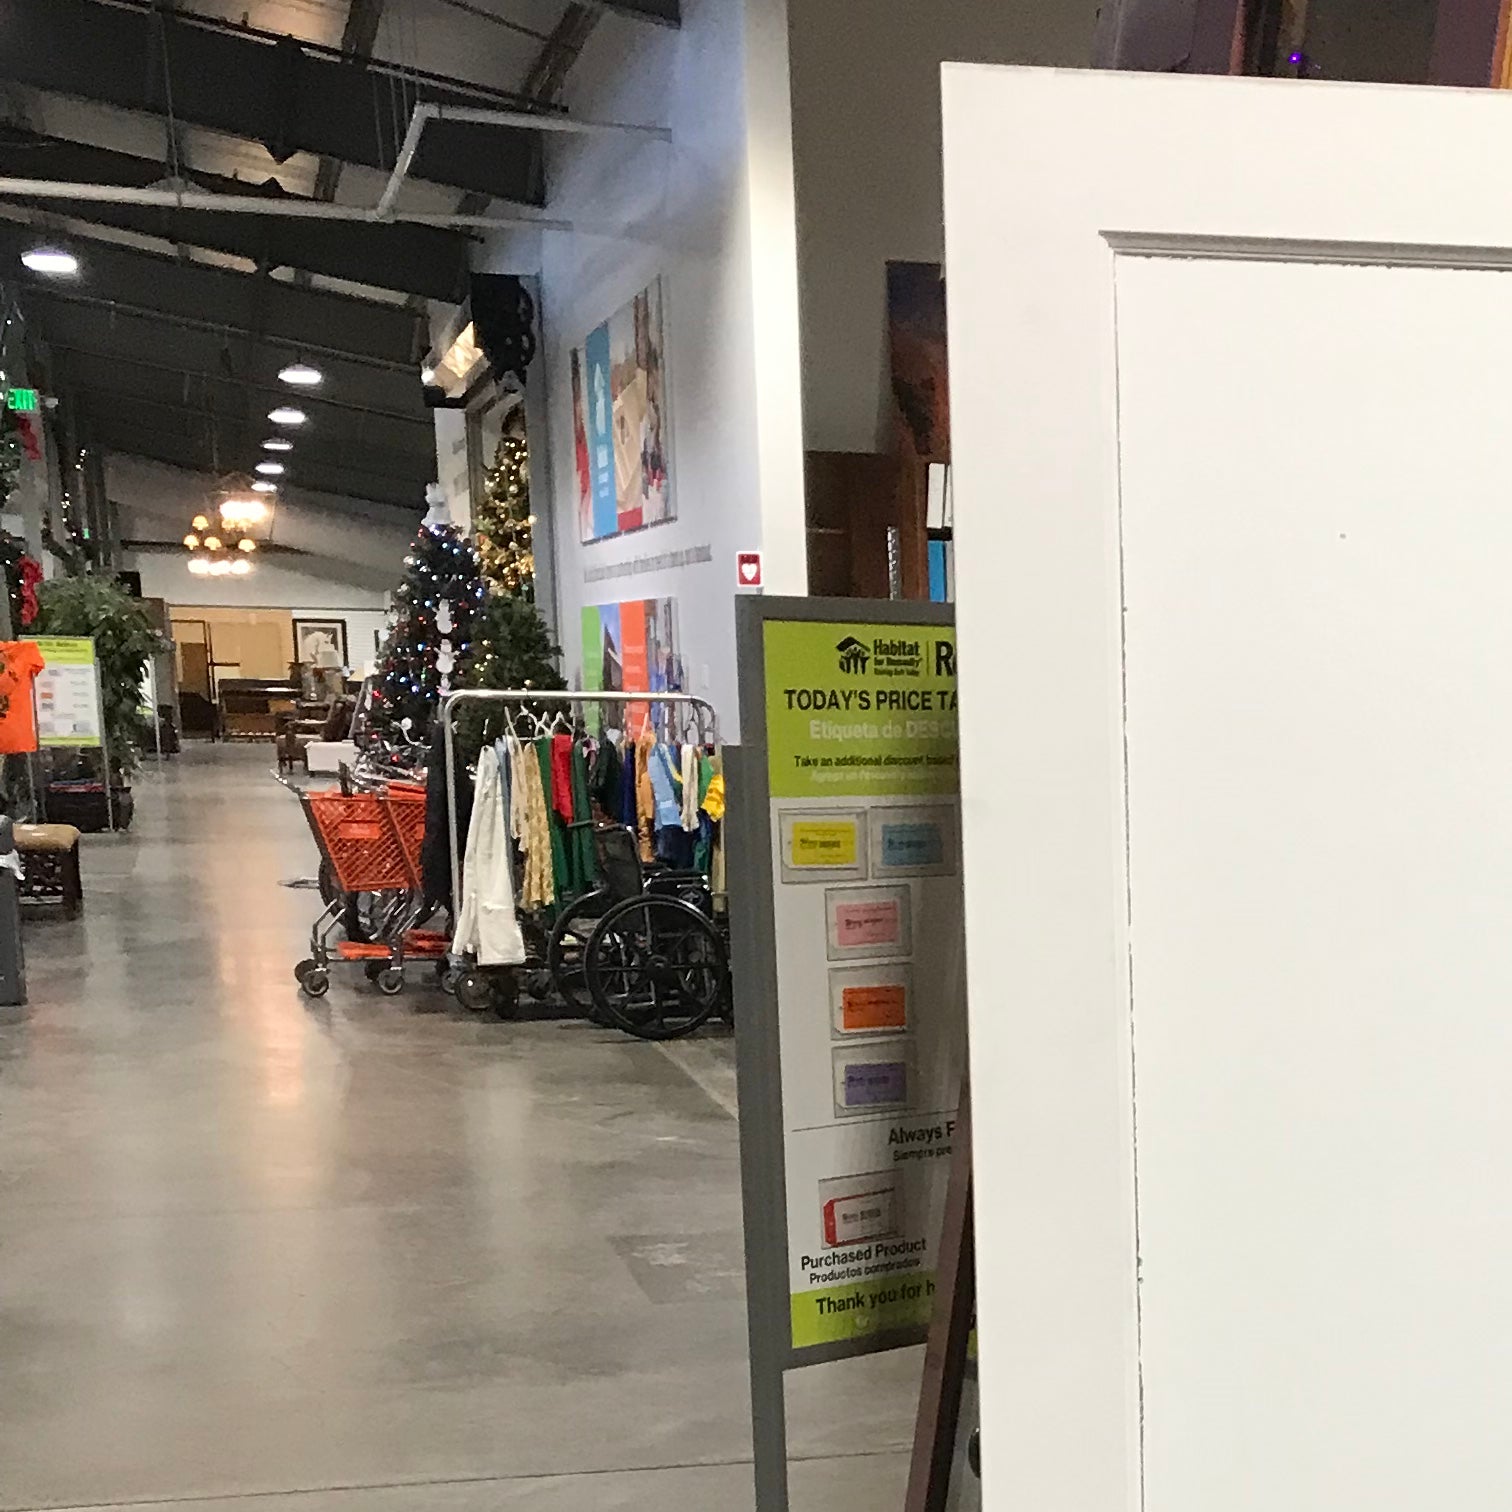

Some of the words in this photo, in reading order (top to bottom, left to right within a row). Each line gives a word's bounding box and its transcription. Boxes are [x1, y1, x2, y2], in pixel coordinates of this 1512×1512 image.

[873, 639, 920, 656] Habitat
[935, 640, 956, 677] R
[783, 689, 871, 711] TODAY'S
[876, 690, 932, 711] PRICE
[810, 719, 880, 742] Etiqueta
[881, 720, 901, 739] de
[794, 755, 819, 768] Take
[820, 757, 833, 768] an
[835, 755, 882, 768] additional
[888, 1125, 943, 1146] Always
[800, 1246, 873, 1271] Purchased
[875, 1238, 927, 1258] Product
[809, 1266, 863, 1285] Productos
[815, 1291, 865, 1316] Thank
[869, 1285, 899, 1310] you
[901, 1281, 923, 1301] for
